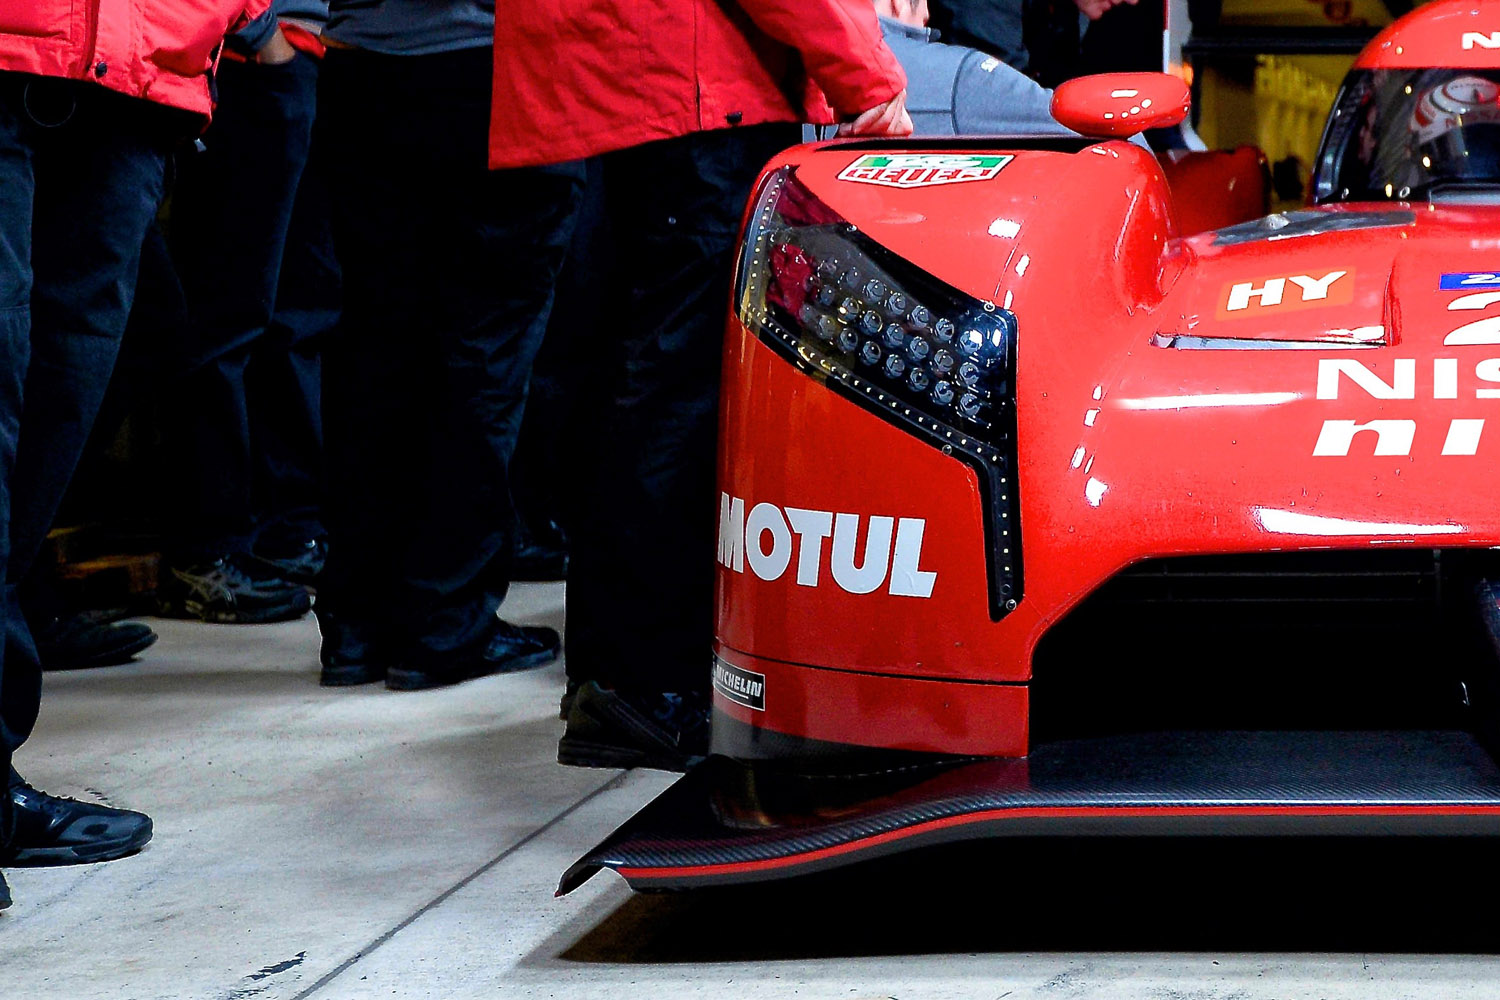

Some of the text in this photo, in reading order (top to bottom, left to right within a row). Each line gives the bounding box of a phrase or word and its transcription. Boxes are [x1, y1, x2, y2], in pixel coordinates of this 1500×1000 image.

[851, 167, 990, 185] HEUER
[1227, 270, 1347, 311] HY
[717, 491, 938, 598] MOTUL
[716, 664, 762, 697] MICHELIN
